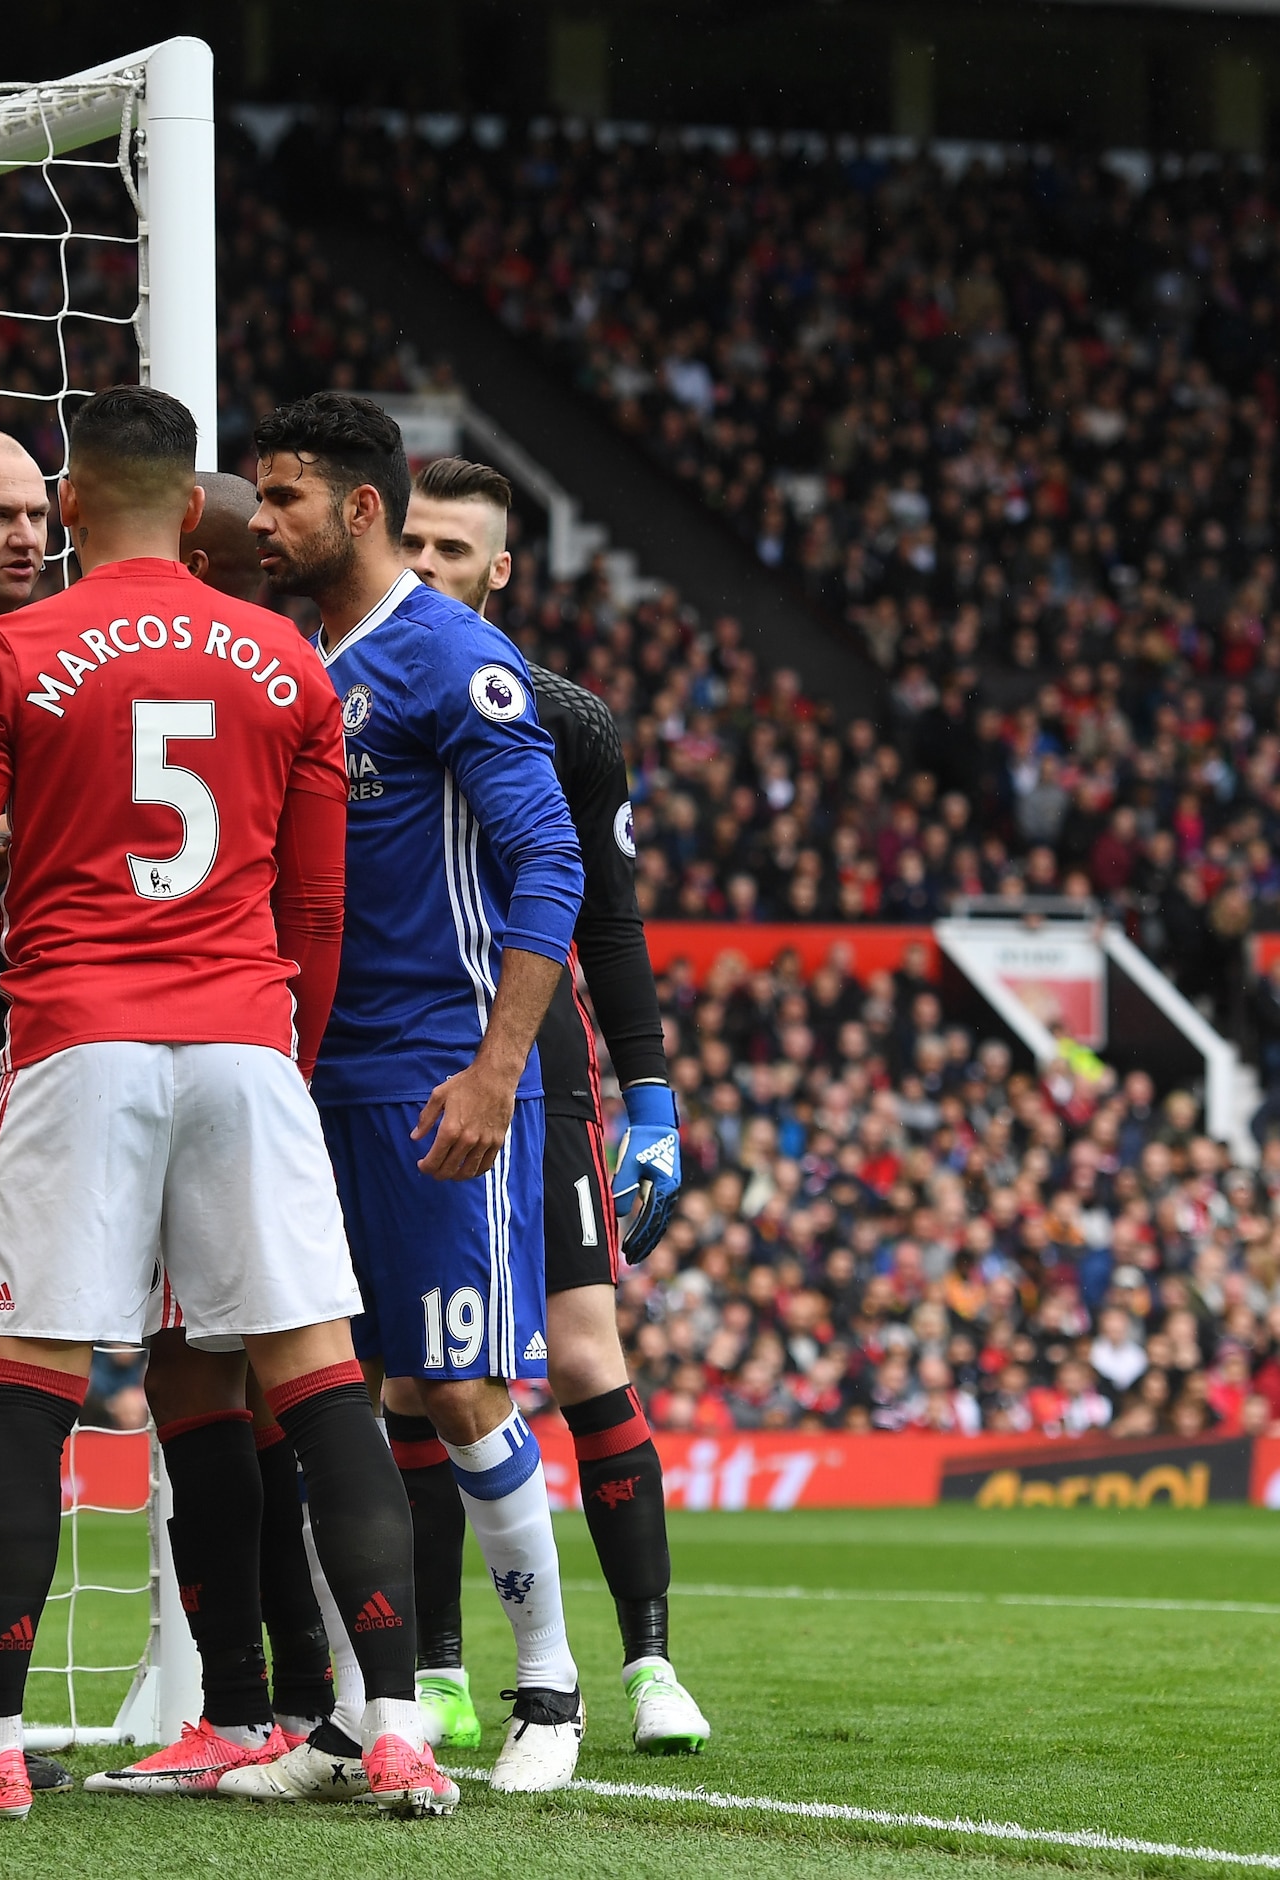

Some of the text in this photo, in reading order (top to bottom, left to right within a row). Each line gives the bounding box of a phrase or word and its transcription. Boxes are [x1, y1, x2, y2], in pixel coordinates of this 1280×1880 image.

[26, 614, 299, 718] MARCOS ROJO
[126, 699, 219, 901] 5
[635, 1134, 676, 1165] adidas
[573, 1174, 599, 1247] 1
[421, 1286, 485, 1369] 19
[354, 1615, 403, 1632] adidas
